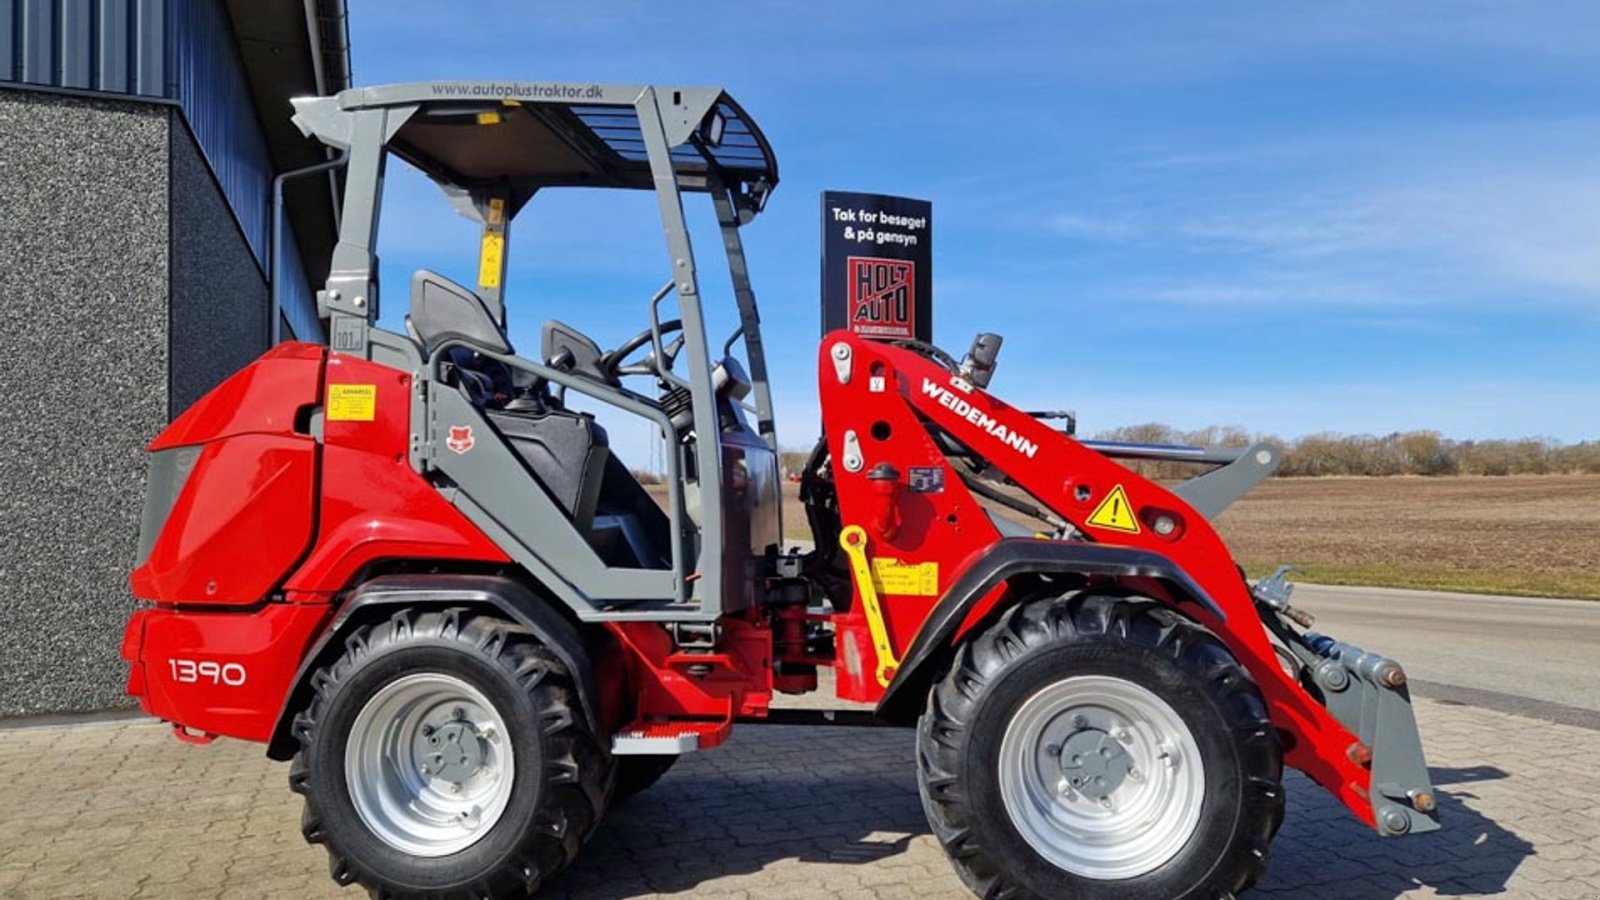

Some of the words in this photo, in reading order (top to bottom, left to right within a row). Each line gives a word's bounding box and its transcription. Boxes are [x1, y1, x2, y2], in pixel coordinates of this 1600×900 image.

[432, 84, 603, 99] www.autoplustraktor.dk
[832, 208, 856, 221] Tak
[859, 210, 877, 223] for
[879, 211, 926, 229] besøget
[844, 227, 855, 240] &
[857, 228, 874, 243] på
[876, 233, 917, 247] gensyn
[856, 263, 907, 302] HOLT
[855, 286, 908, 323] AUTO
[921, 377, 1038, 458] WEIDEMANN
[168, 658, 246, 686] 1390
